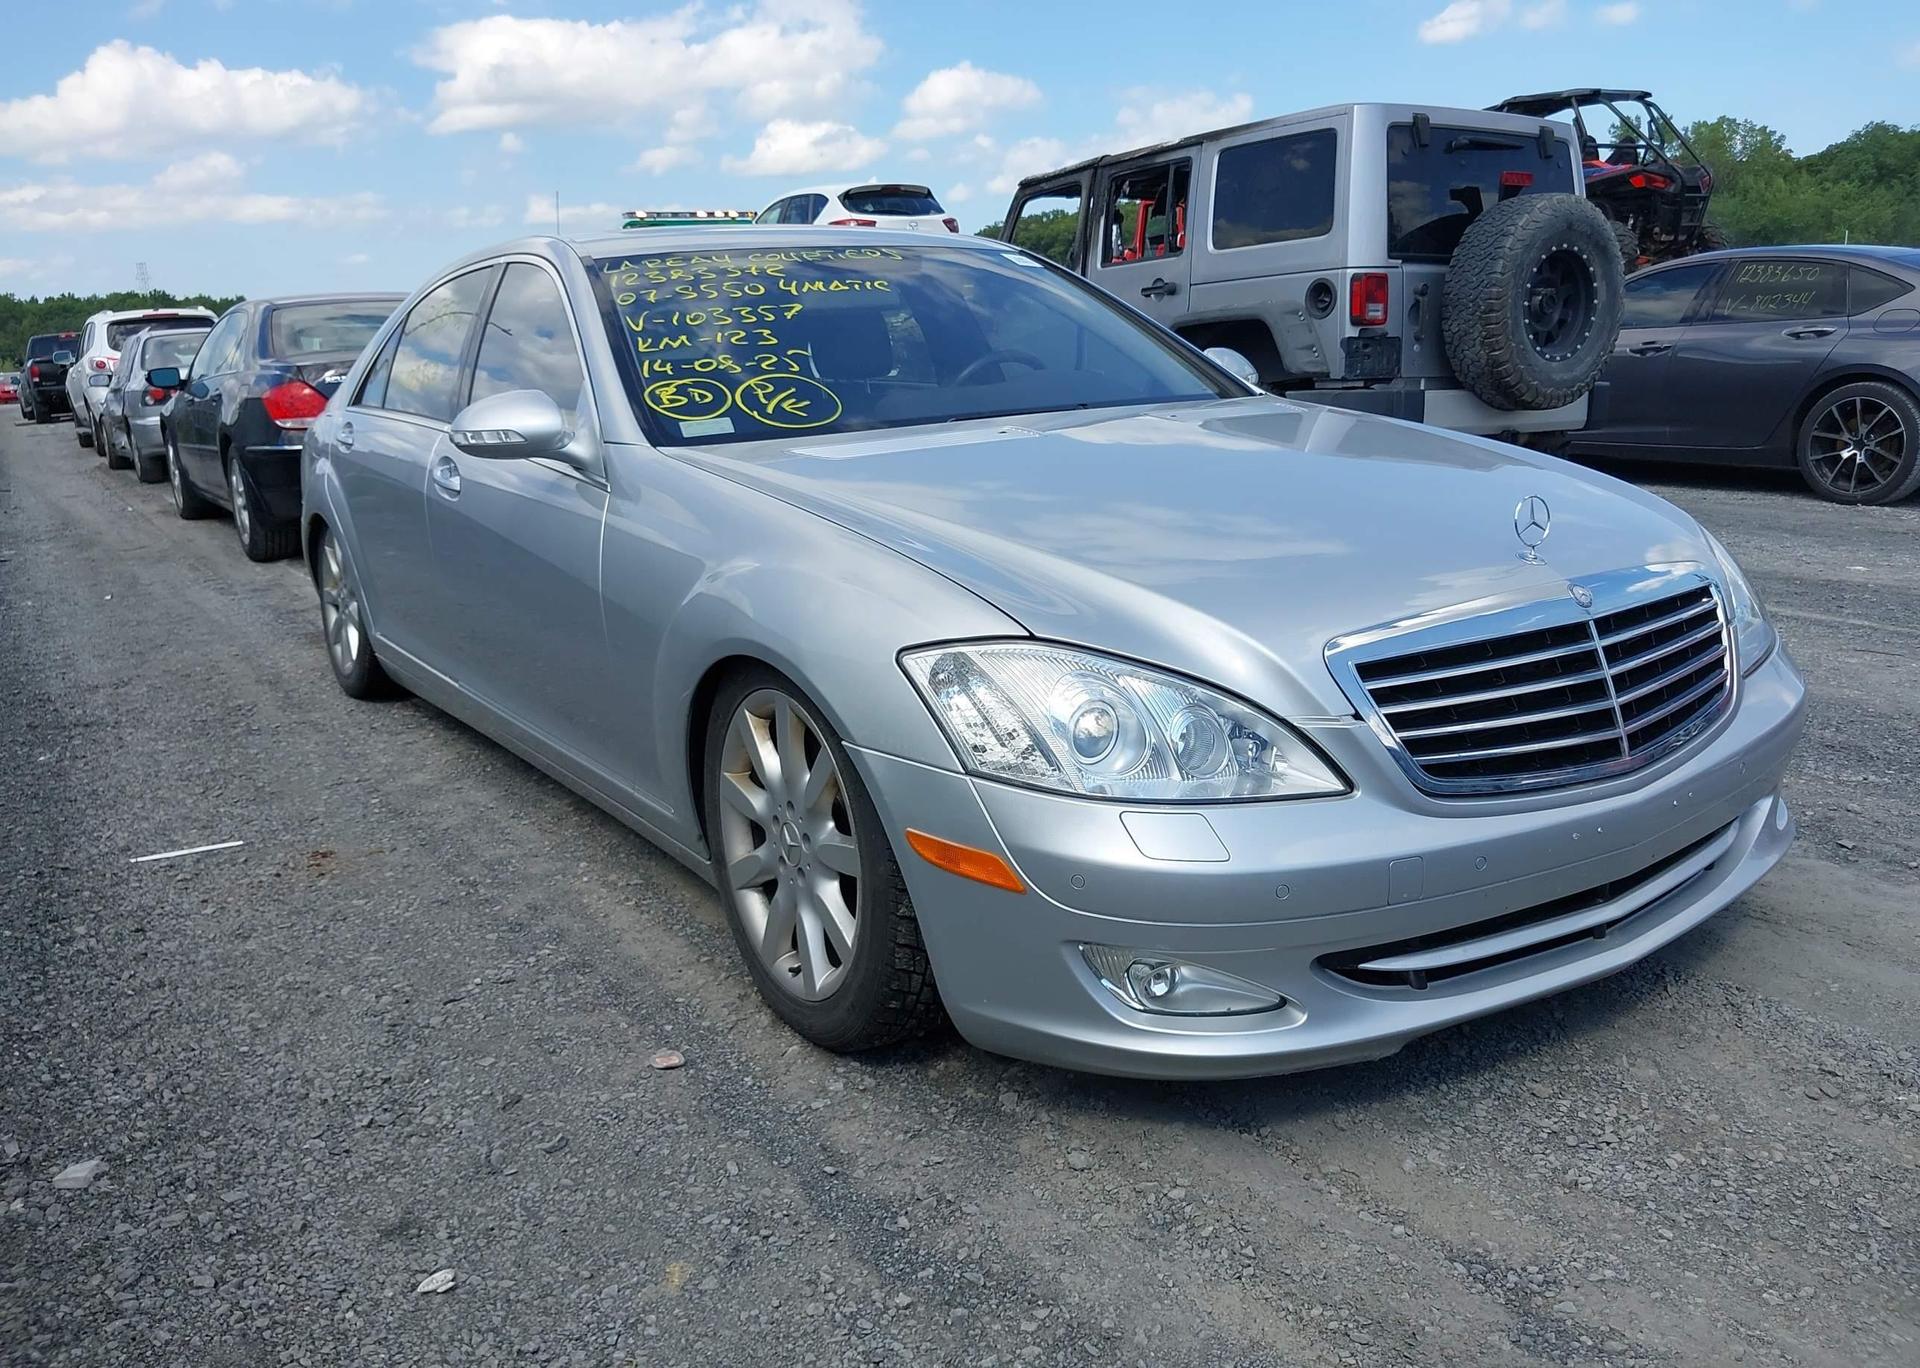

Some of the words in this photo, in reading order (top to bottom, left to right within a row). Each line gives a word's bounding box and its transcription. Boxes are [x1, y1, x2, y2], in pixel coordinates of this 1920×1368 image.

[1736, 264, 1820, 283] 12383650
[778, 278, 893, 296] 4MATIC
[1724, 290, 1816, 316] V-802344
